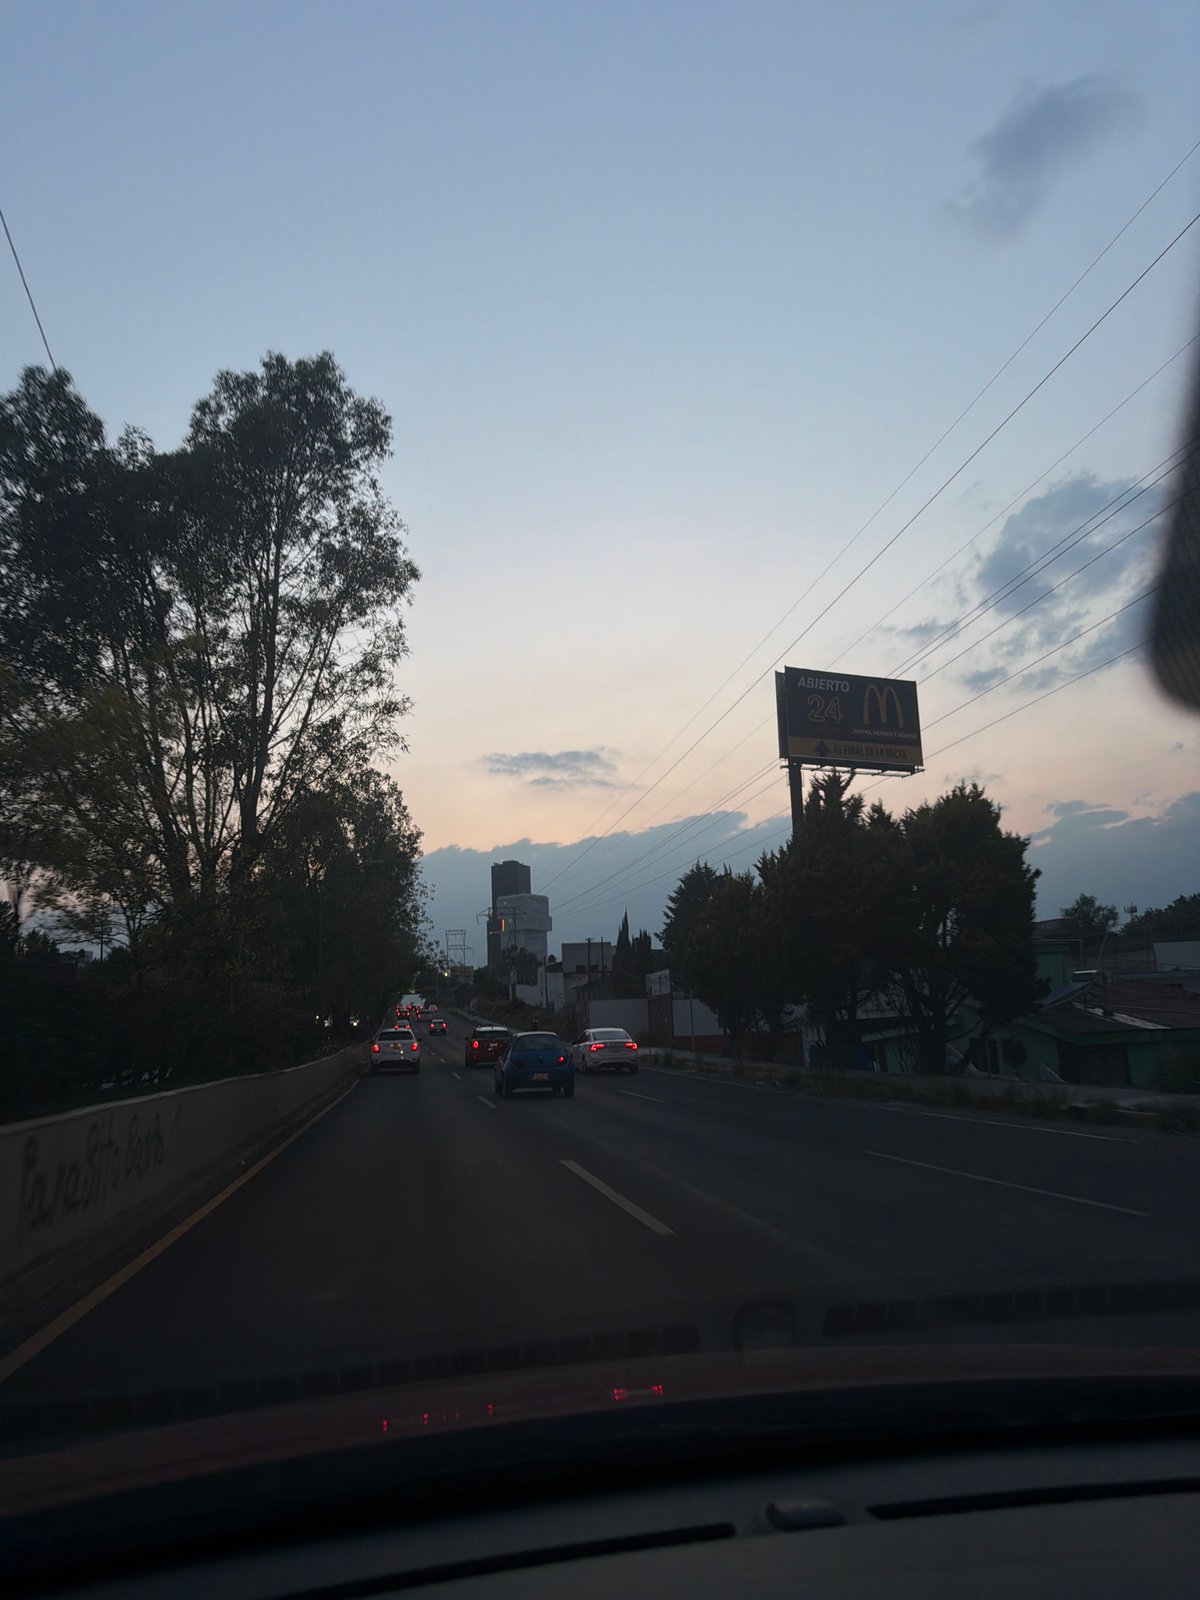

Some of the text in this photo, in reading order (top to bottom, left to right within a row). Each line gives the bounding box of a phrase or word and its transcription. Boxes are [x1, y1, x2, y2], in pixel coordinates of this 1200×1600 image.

[799, 677, 849, 692] ABIERTO
[808, 695, 844, 724] 24
[844, 745, 864, 756] FINAL
[865, 747, 874, 757] DE
[875, 748, 884, 757] LA
